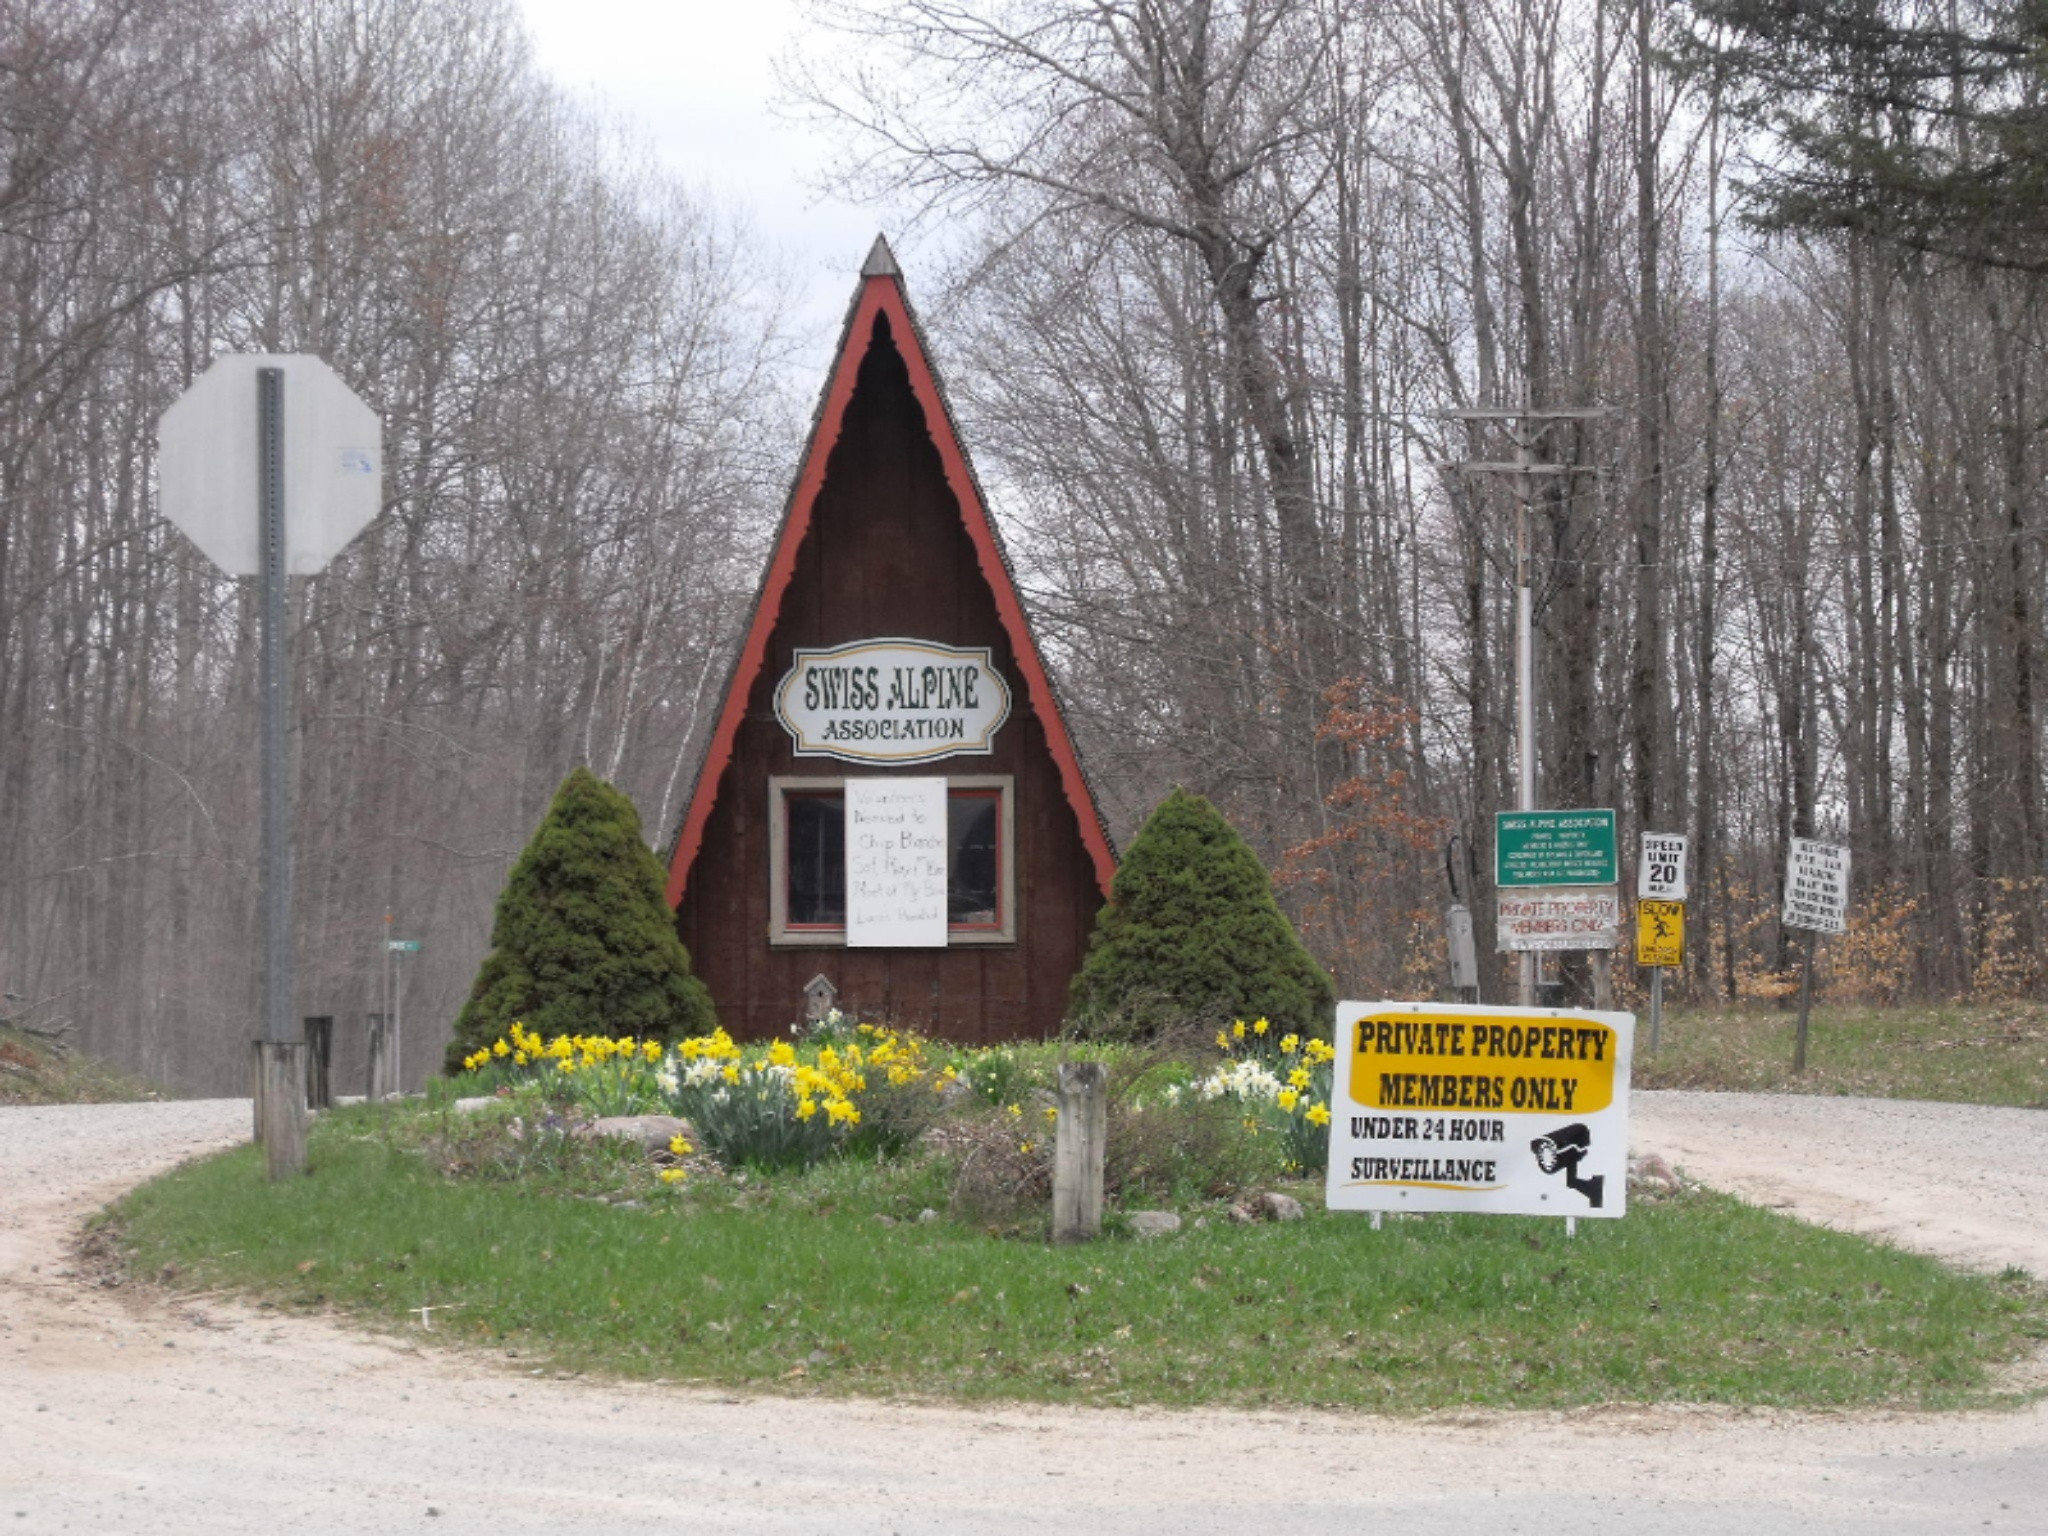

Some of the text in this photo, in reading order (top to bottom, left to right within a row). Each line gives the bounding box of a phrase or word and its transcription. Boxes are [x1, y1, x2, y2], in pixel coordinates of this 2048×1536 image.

[805, 665, 980, 711] SWISS ALPINE
[822, 717, 965, 740] ASSOCIATION
[1645, 840, 1683, 851] SPEED
[1648, 852, 1679, 863] LIMIT
[1650, 864, 1677, 884] 20
[1500, 899, 1614, 917] PRIVATE PROPERTY
[1643, 902, 1680, 916] SLOW
[1510, 919, 1568, 934] MEMBERS
[1358, 1021, 1608, 1061] PRIVATE PROPERTY
[1379, 1073, 1577, 1111] MEMBERS ONLY
[1350, 1117, 1505, 1143] UNDER 24 HOUR
[1350, 1157, 1496, 1182] SURVEILLANCE
